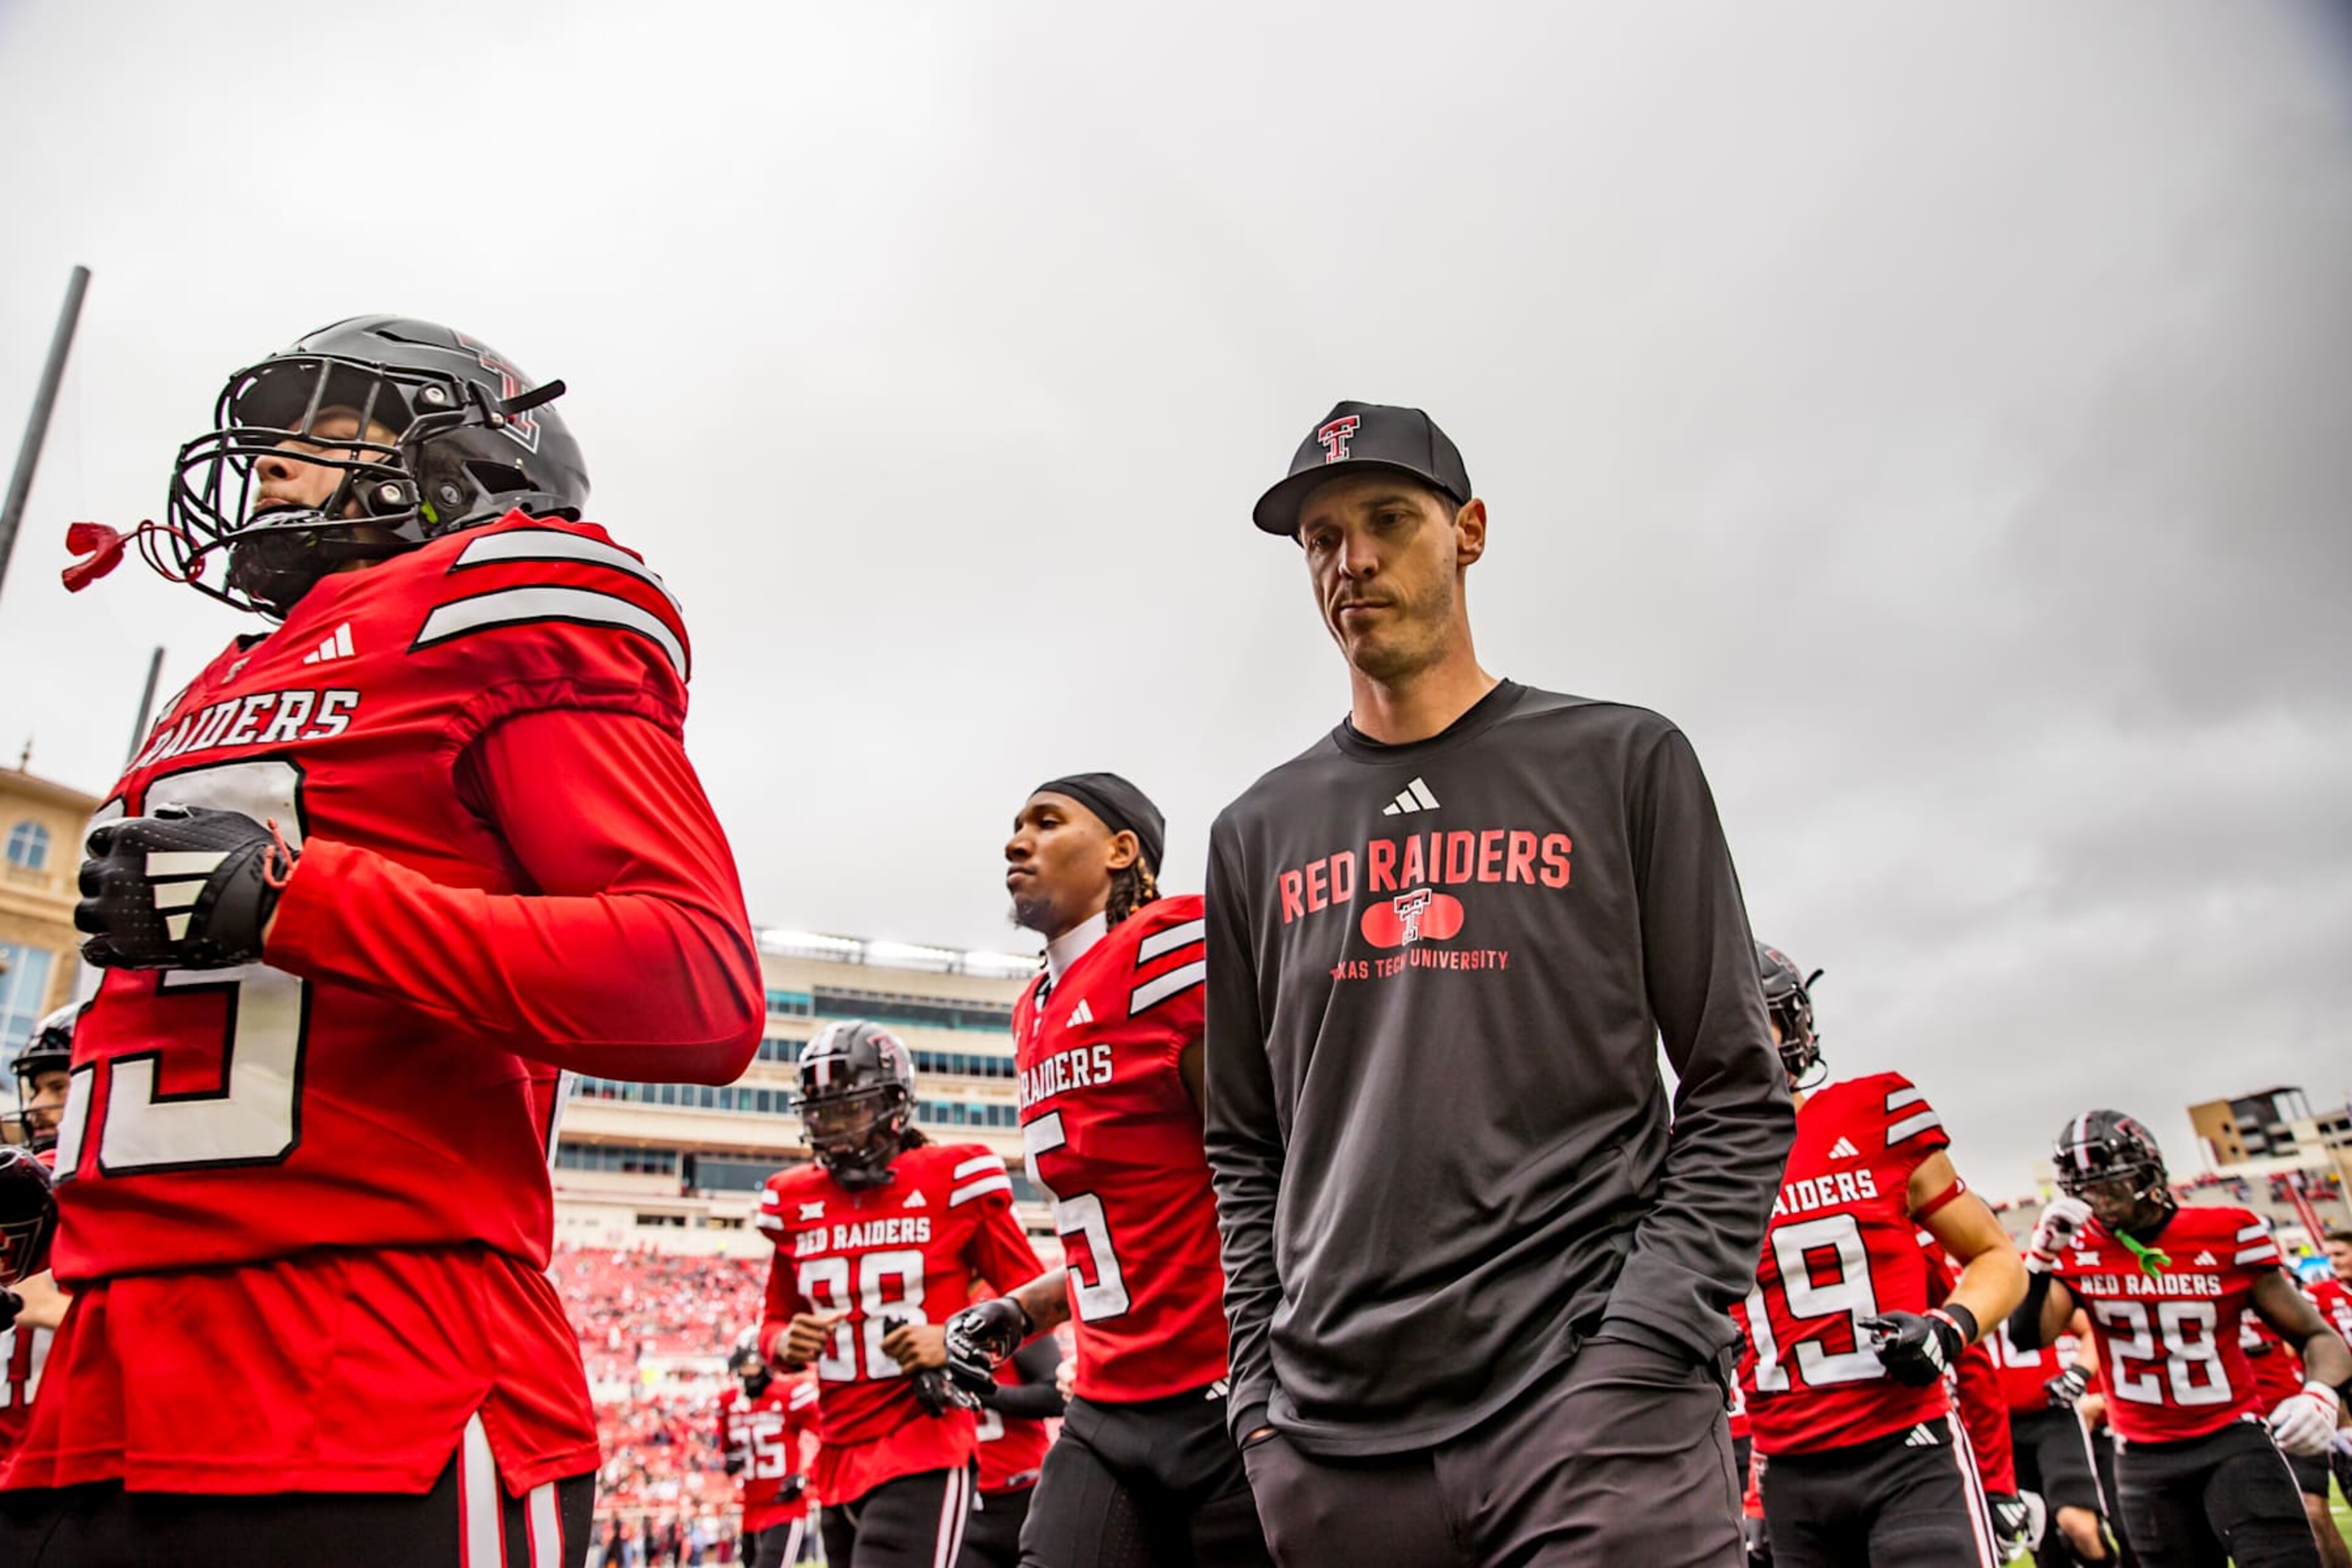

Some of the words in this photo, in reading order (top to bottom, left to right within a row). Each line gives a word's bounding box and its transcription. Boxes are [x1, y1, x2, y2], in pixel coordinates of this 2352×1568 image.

[125, 690, 360, 775] RAIDERS
[1279, 850, 1355, 925] RED
[1368, 829, 1572, 892] RAIDERS
[1329, 960, 1369, 981] TXAS
[1375, 951, 1407, 979] TECH
[1409, 948, 1509, 971] UNIVERSITY
[1020, 1044, 1113, 1110] RAIDERS
[1023, 1111, 1131, 1322] 5
[1771, 1169, 1879, 1219] AIDERS
[794, 1227, 827, 1257] RED
[832, 1216, 931, 1250] RAIDERS
[1744, 1213, 1887, 1392] 19
[2080, 1275, 2120, 1295] RED
[2125, 1275, 2223, 1296] RAIDERS
[2092, 1300, 2233, 1406] 28
